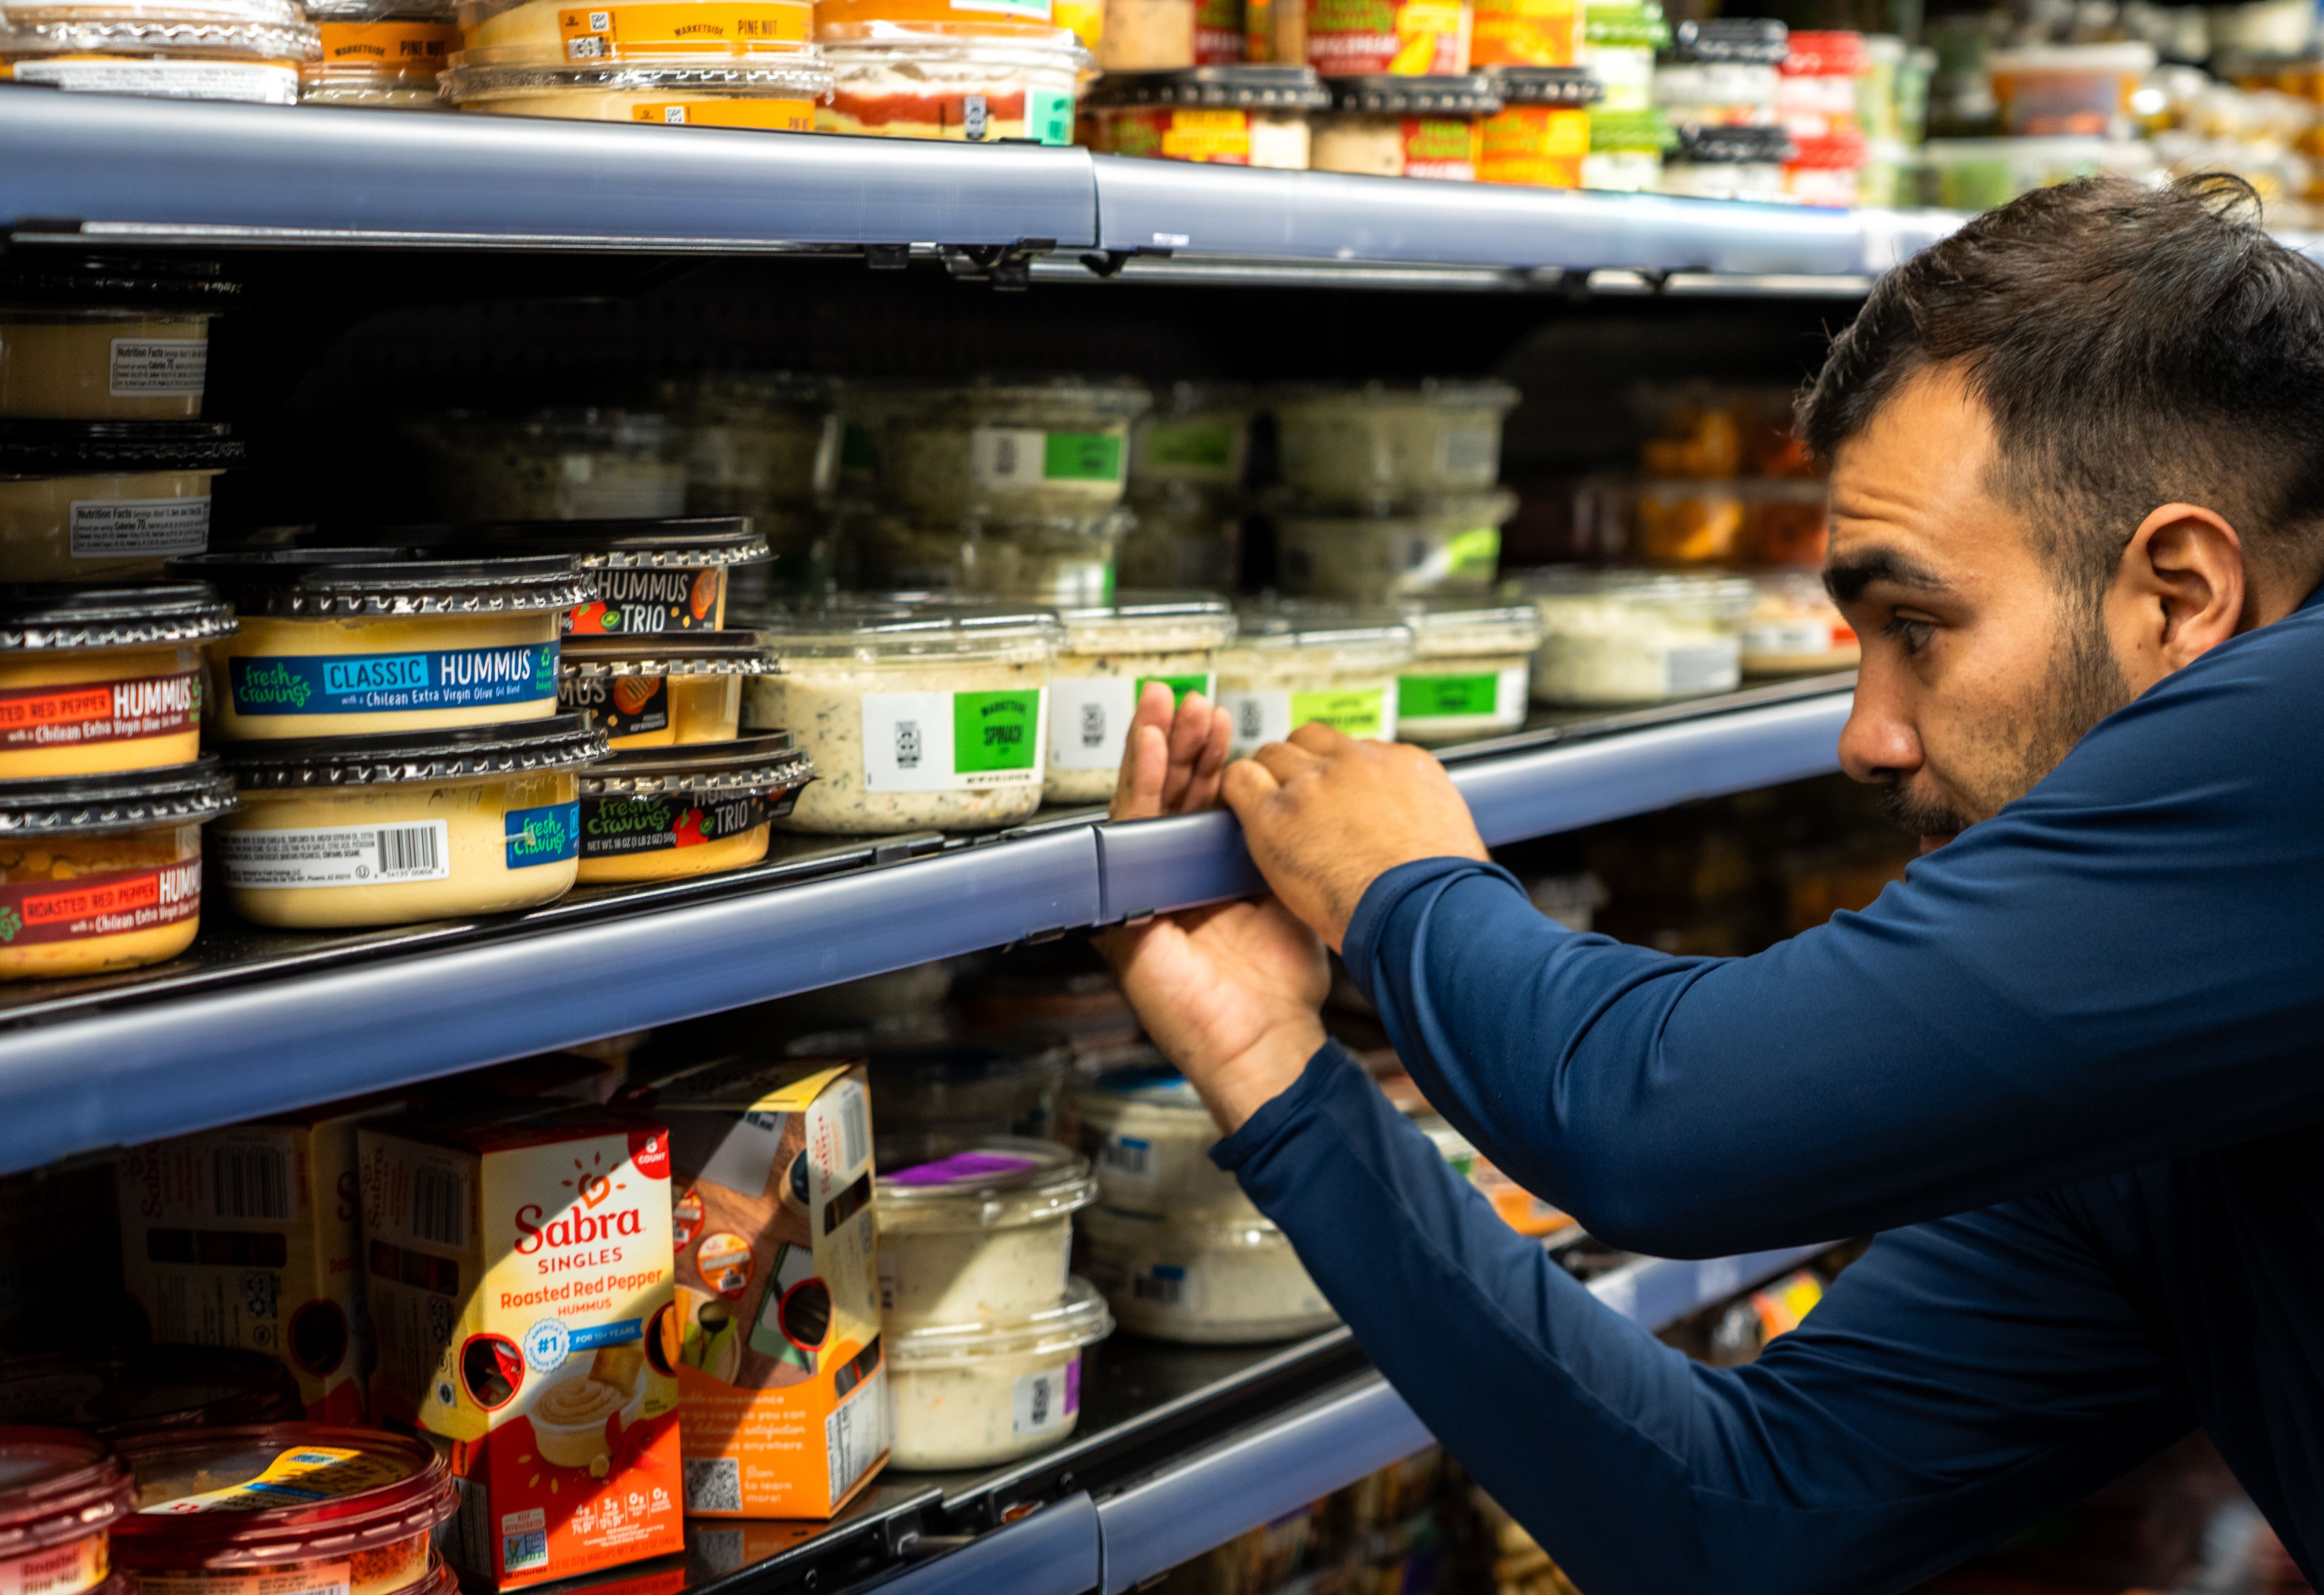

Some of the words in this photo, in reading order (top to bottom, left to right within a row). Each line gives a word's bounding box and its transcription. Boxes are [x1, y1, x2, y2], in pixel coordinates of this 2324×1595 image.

[738, 20, 758, 35] PINE
[761, 20, 777, 35] NUT
[401, 40, 423, 56] PINE
[118, 347, 146, 358] Nutrition
[148, 347, 164, 357] Facts
[78, 508, 111, 519] Nutrition
[113, 508, 132, 519] Facts
[115, 521, 136, 531] Calories
[137, 518, 146, 530] 70
[597, 571, 689, 603] HUMMUS
[621, 604, 666, 633] TRIO
[245, 662, 294, 688] fresh
[330, 659, 422, 689] CLASSIC
[440, 648, 531, 686] HUMMUS
[113, 676, 191, 718] HUMMUS
[366, 690, 409, 708] Chilean
[411, 687, 439, 704] Extra
[443, 687, 471, 705] Virgin
[474, 686, 494, 701] Olive
[559, 678, 606, 706] MUS
[35, 724, 81, 744] Chilean
[82, 720, 112, 739] Extra
[113, 717, 141, 737] Virgin
[522, 811, 559, 837] fresh
[715, 800, 749, 835] TRIO
[587, 840, 600, 851] NET
[622, 837, 631, 848] OZ
[647, 834, 652, 846] 2
[159, 861, 201, 905] HUMM
[95, 913, 135, 933] Chilean
[135, 907, 158, 925] Extra
[646, 1137, 658, 1154] 6
[638, 1151, 666, 1165] COUNT
[514, 1204, 642, 1255] Sabra
[538, 1246, 623, 1275] SINGLES
[501, 1282, 571, 1310] Roasted
[574, 1277, 604, 1298] Red
[607, 1269, 663, 1291] Pepper
[558, 1297, 612, 1318] HUMMUS
[538, 1336, 558, 1355] #1
[576, 1334, 593, 1344] FOR
[609, 1326, 635, 1337] YEARS
[758, 1412, 781, 1423] you
[783, 1410, 806, 1420] can
[743, 1440, 804, 1452] anywhere
